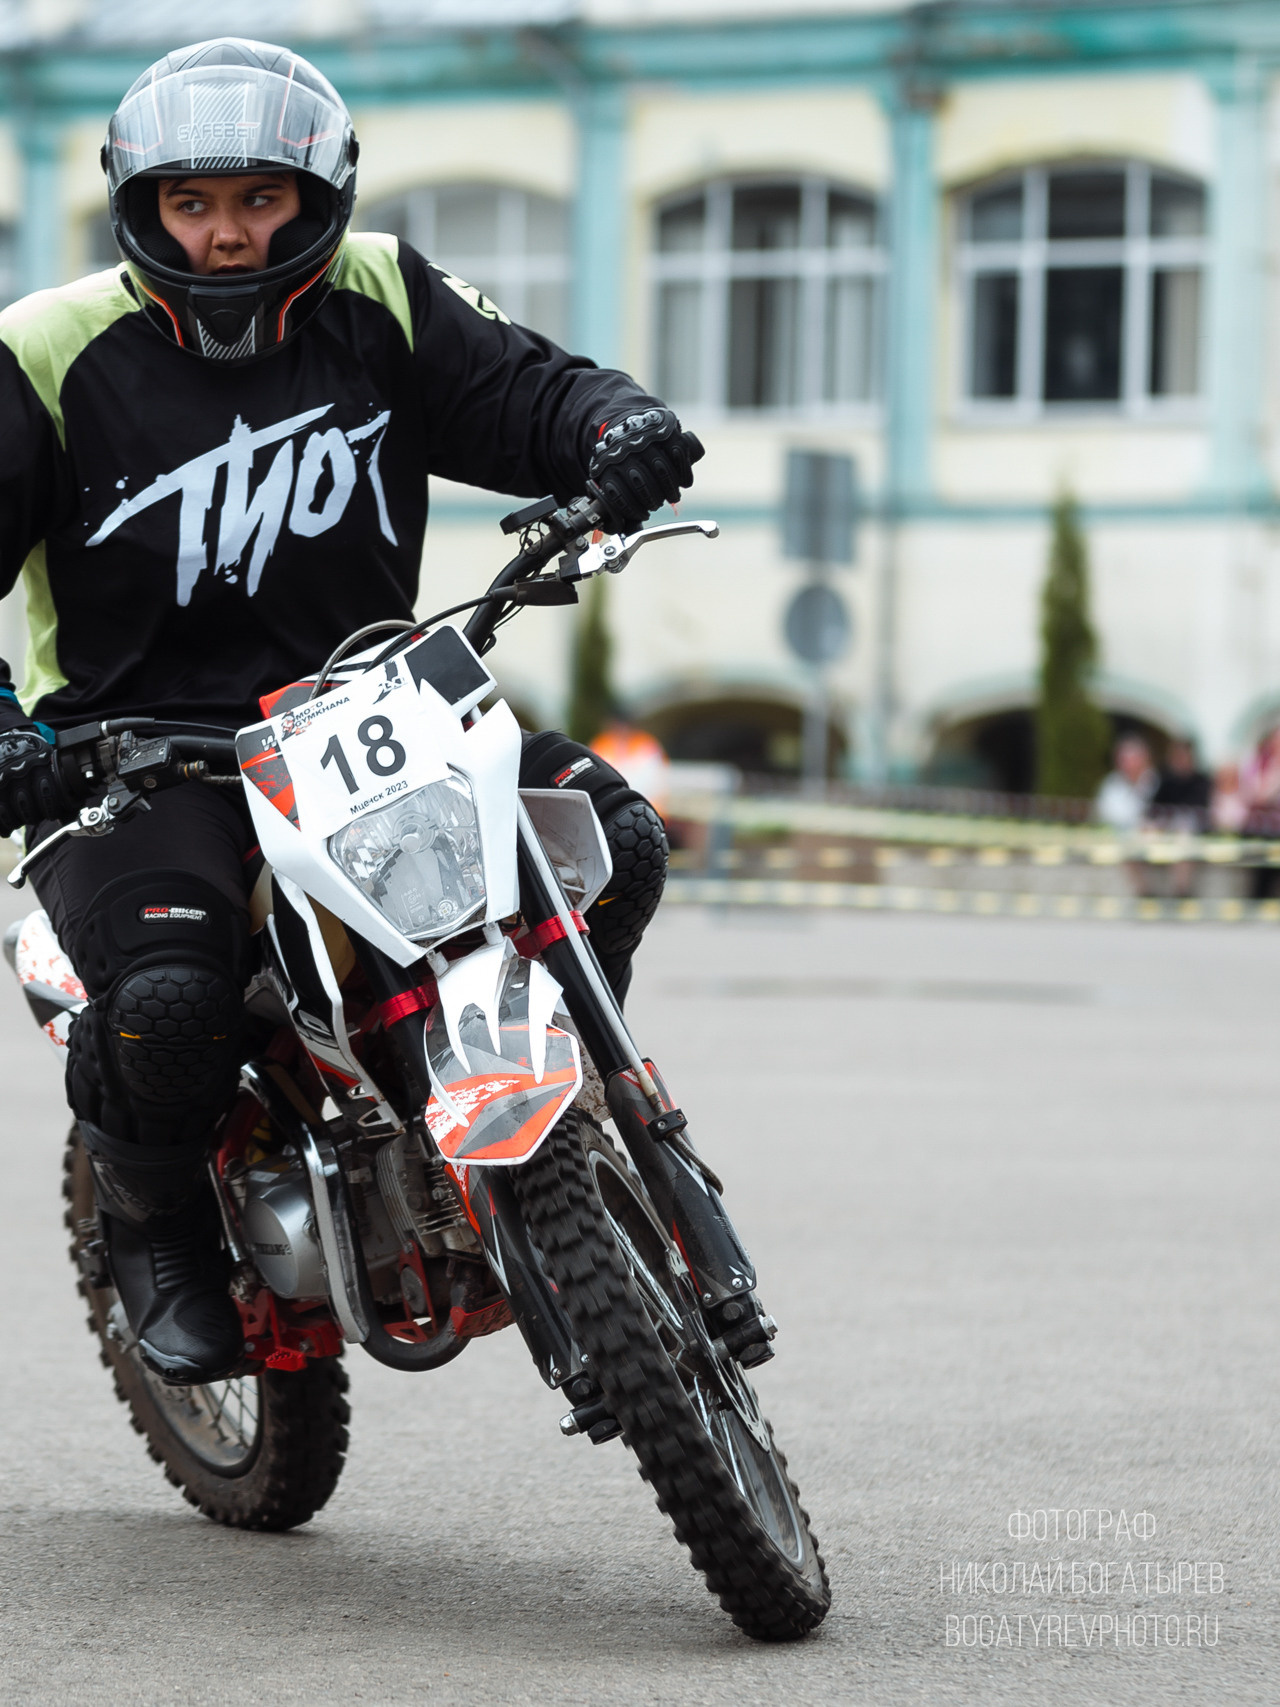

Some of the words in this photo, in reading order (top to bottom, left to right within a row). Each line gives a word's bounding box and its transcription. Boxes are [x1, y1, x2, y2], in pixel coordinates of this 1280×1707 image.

[177, 121, 261, 143] SAFEBET
[295, 697, 350, 727] GYMKHANA
[320, 715, 406, 795] 18
[385, 780, 409, 796] 2023
